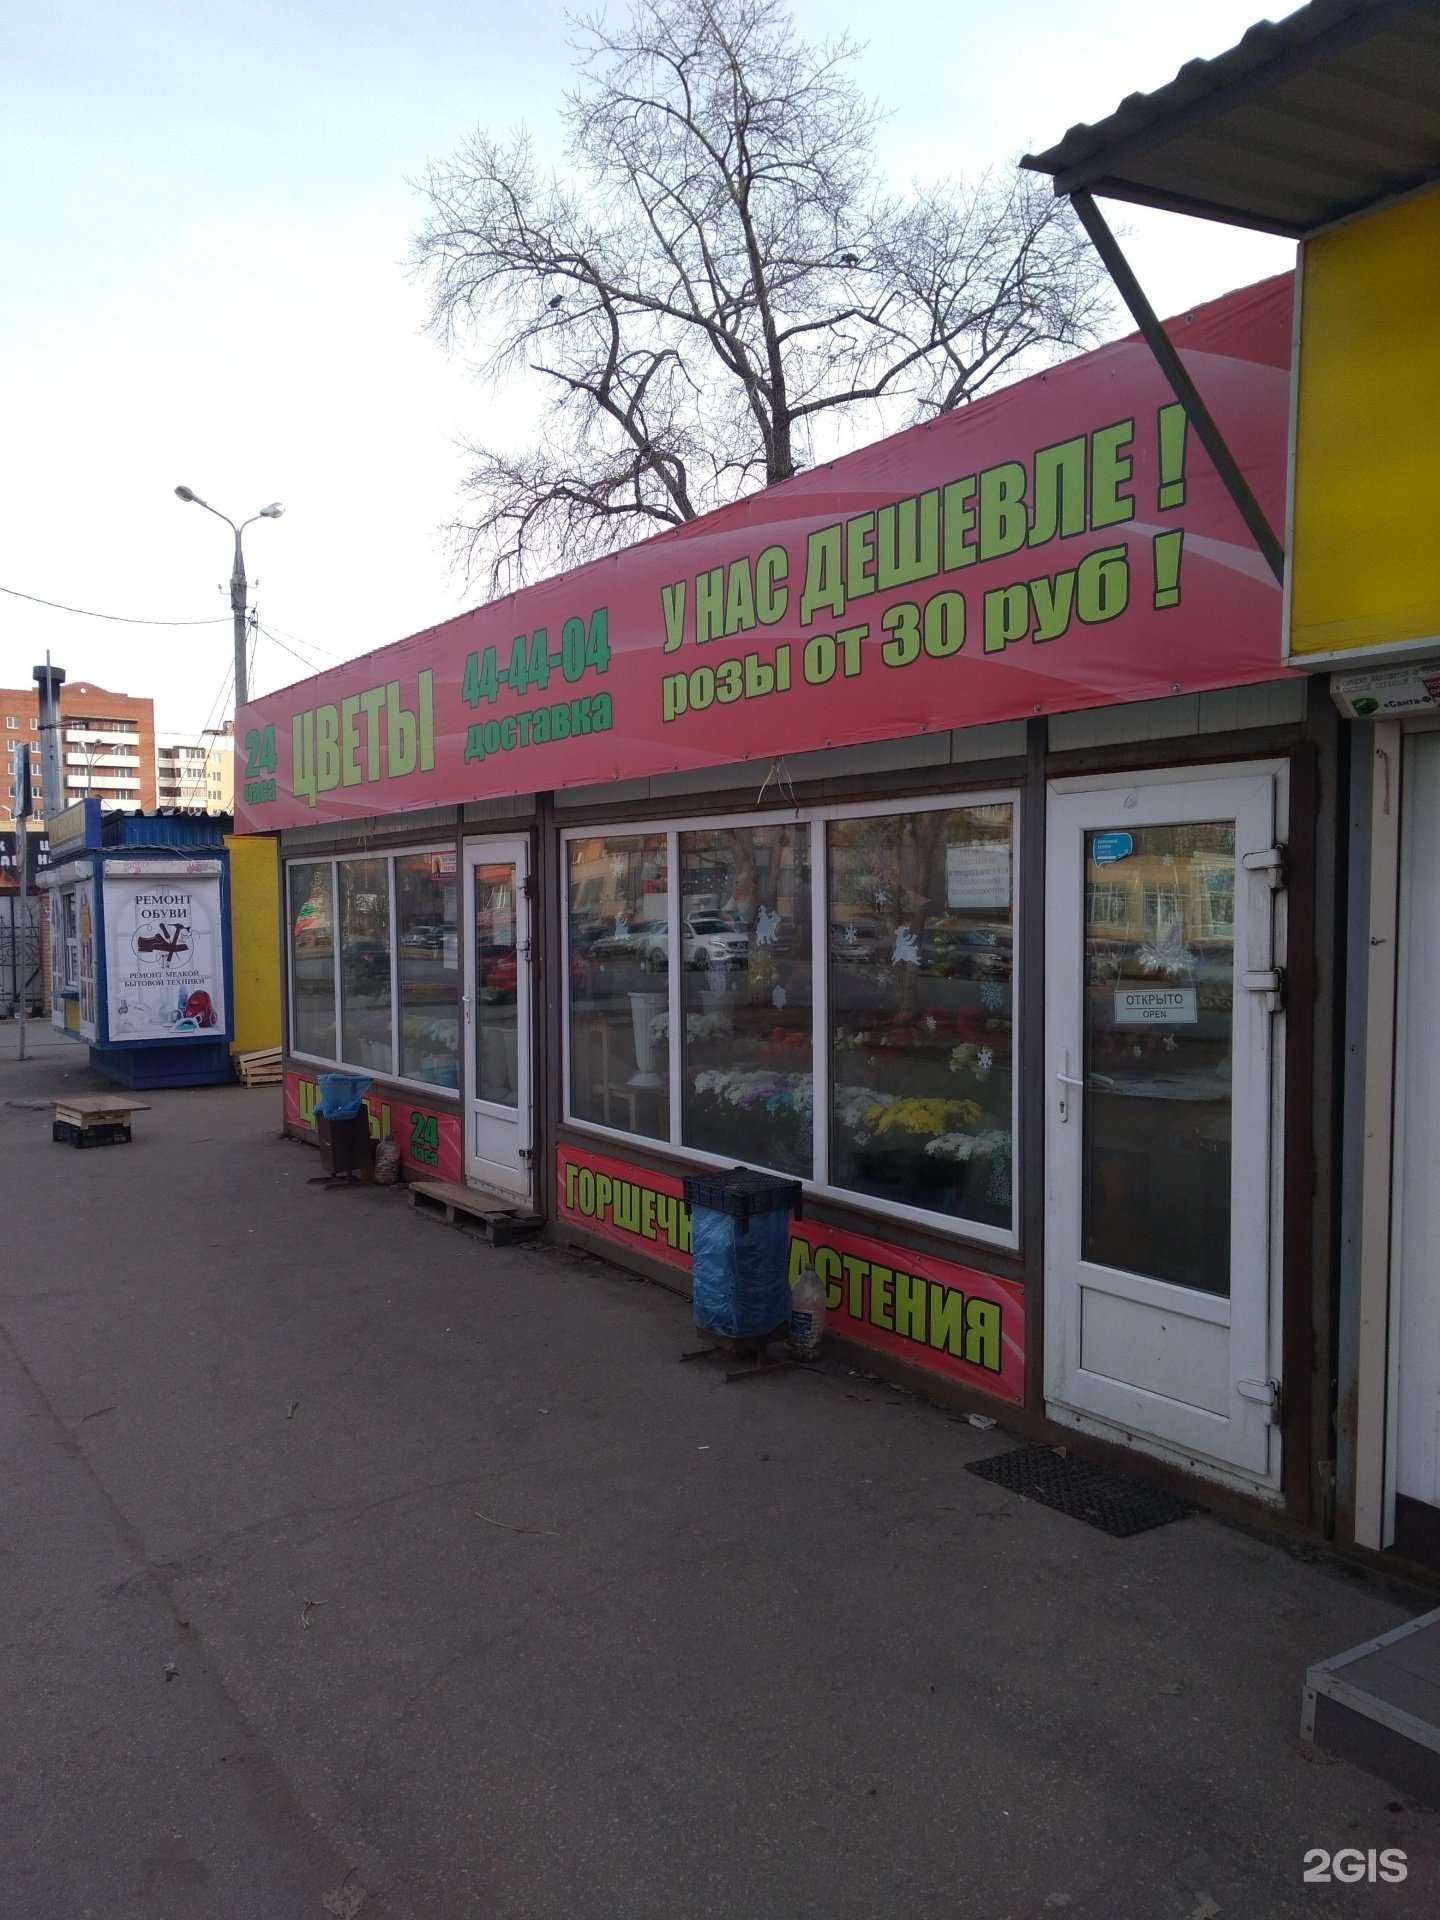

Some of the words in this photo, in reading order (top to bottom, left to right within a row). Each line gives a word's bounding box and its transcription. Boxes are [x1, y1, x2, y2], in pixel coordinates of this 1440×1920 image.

[661, 580, 687, 654] У
[695, 544, 789, 646] НАС
[800, 416, 1136, 627] ДЕШЕВЛЕ
[662, 643, 792, 723] розы
[802, 623, 870, 687] от
[880, 589, 967, 669] 30
[983, 542, 1130, 655] руб
[462, 606, 612, 709] 44-44-04
[291, 668, 436, 808] ЦВЕТЫ
[464, 691, 613, 766] доставка
[245, 724, 277, 779] 24
[244, 779, 277, 806] часа
[135, 894, 193, 906] РЕМОНТ
[141, 908, 188, 919] ОБУВИ
[124, 979, 164, 988] БЫТОВОЙ
[166, 977, 205, 987] ТЕХНИКИ
[129, 971, 162, 980] РЕМОНТ
[165, 969, 200, 979] МЕЛКОЙ
[1126, 993, 1184, 1006] ОТКРЫТО
[1142, 1010, 1168, 1019] OPEN
[410, 1111, 439, 1150] 24
[410, 1144, 439, 1168] часа
[564, 1161, 693, 1257] ГОРШЕЧН
[787, 1235, 1002, 1374] АСТЕНИЯ
